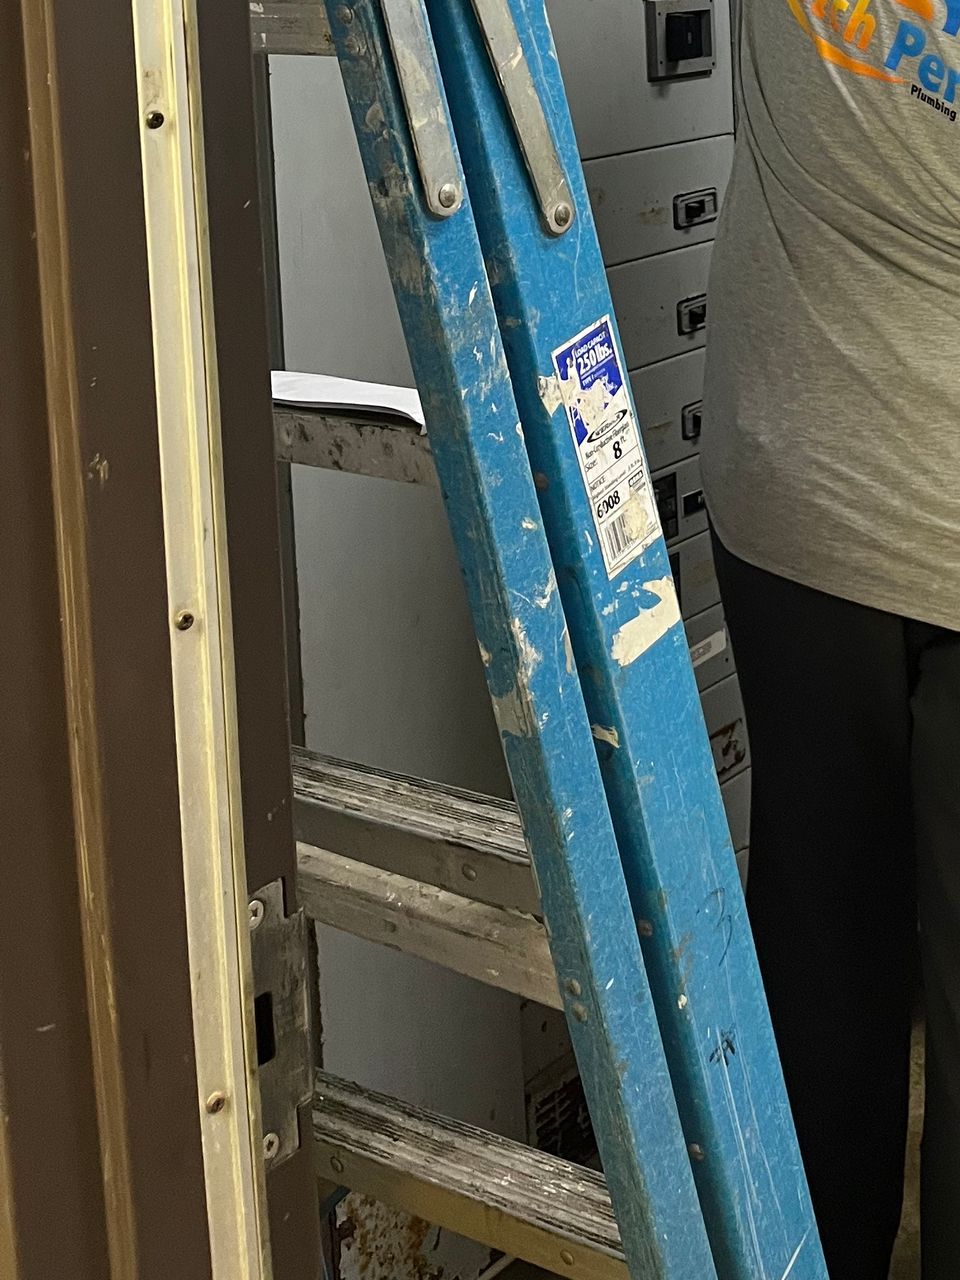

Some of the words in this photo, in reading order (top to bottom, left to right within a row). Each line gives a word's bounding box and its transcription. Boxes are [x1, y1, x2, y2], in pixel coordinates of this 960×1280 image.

[910, 84, 957, 122] Plumbing
[577, 348, 597, 376] 250
[594, 342, 613, 363] lbs.
[612, 440, 623, 460] 8
